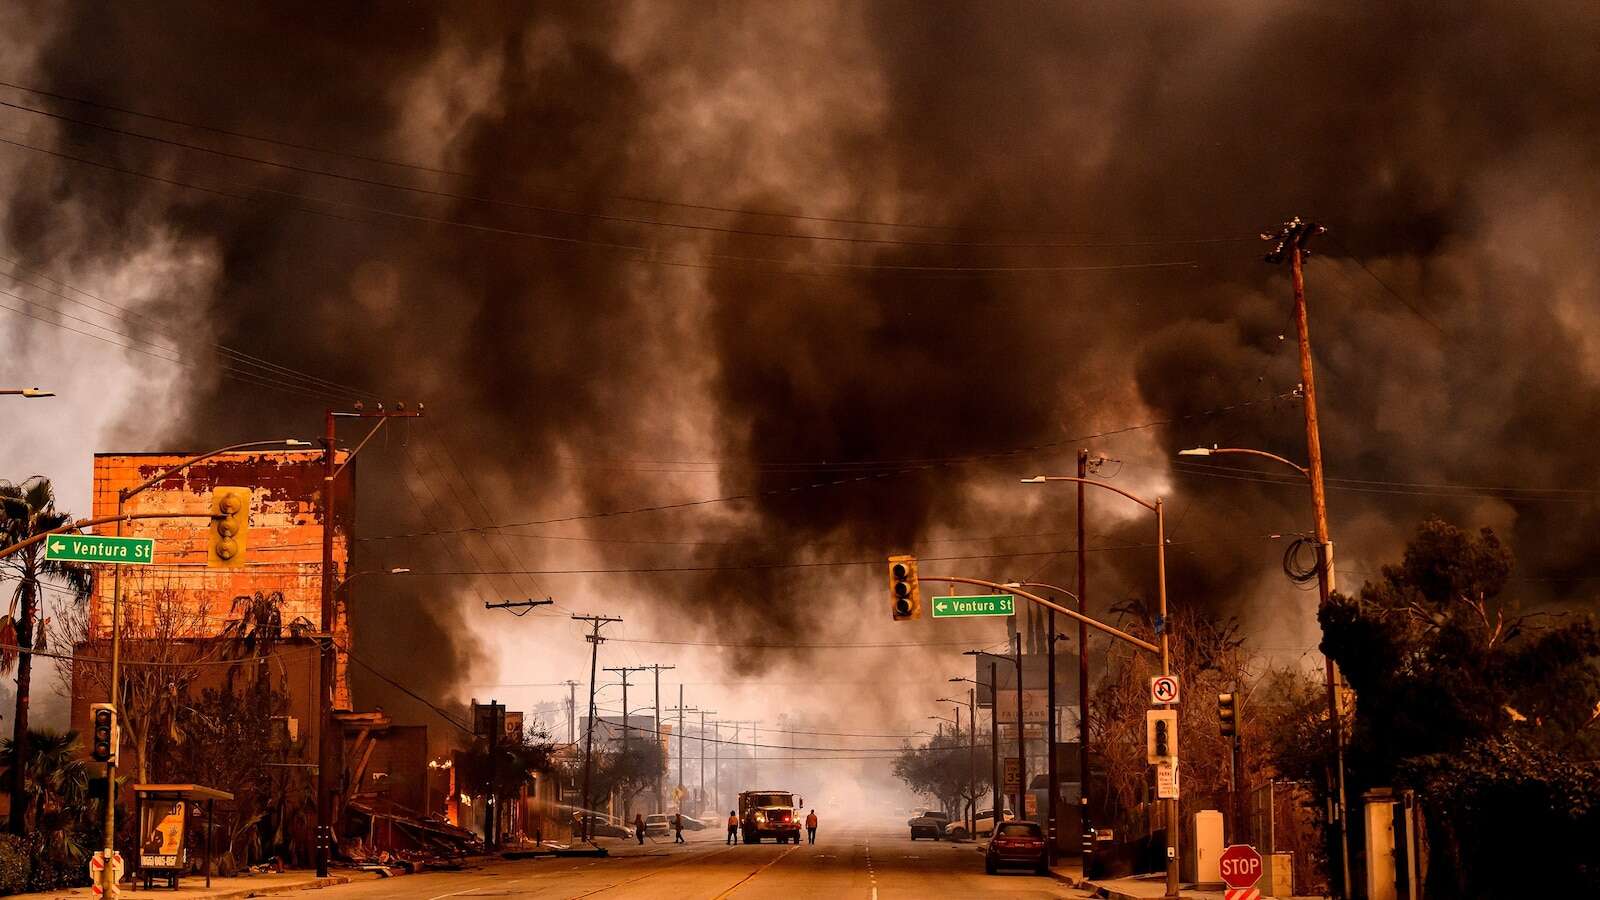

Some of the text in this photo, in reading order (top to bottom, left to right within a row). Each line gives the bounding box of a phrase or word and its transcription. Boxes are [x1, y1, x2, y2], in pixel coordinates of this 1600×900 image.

[73, 541, 151, 558] Ventura St
[952, 599, 1012, 612] Ventura St
[1222, 858, 1259, 876] STOP
